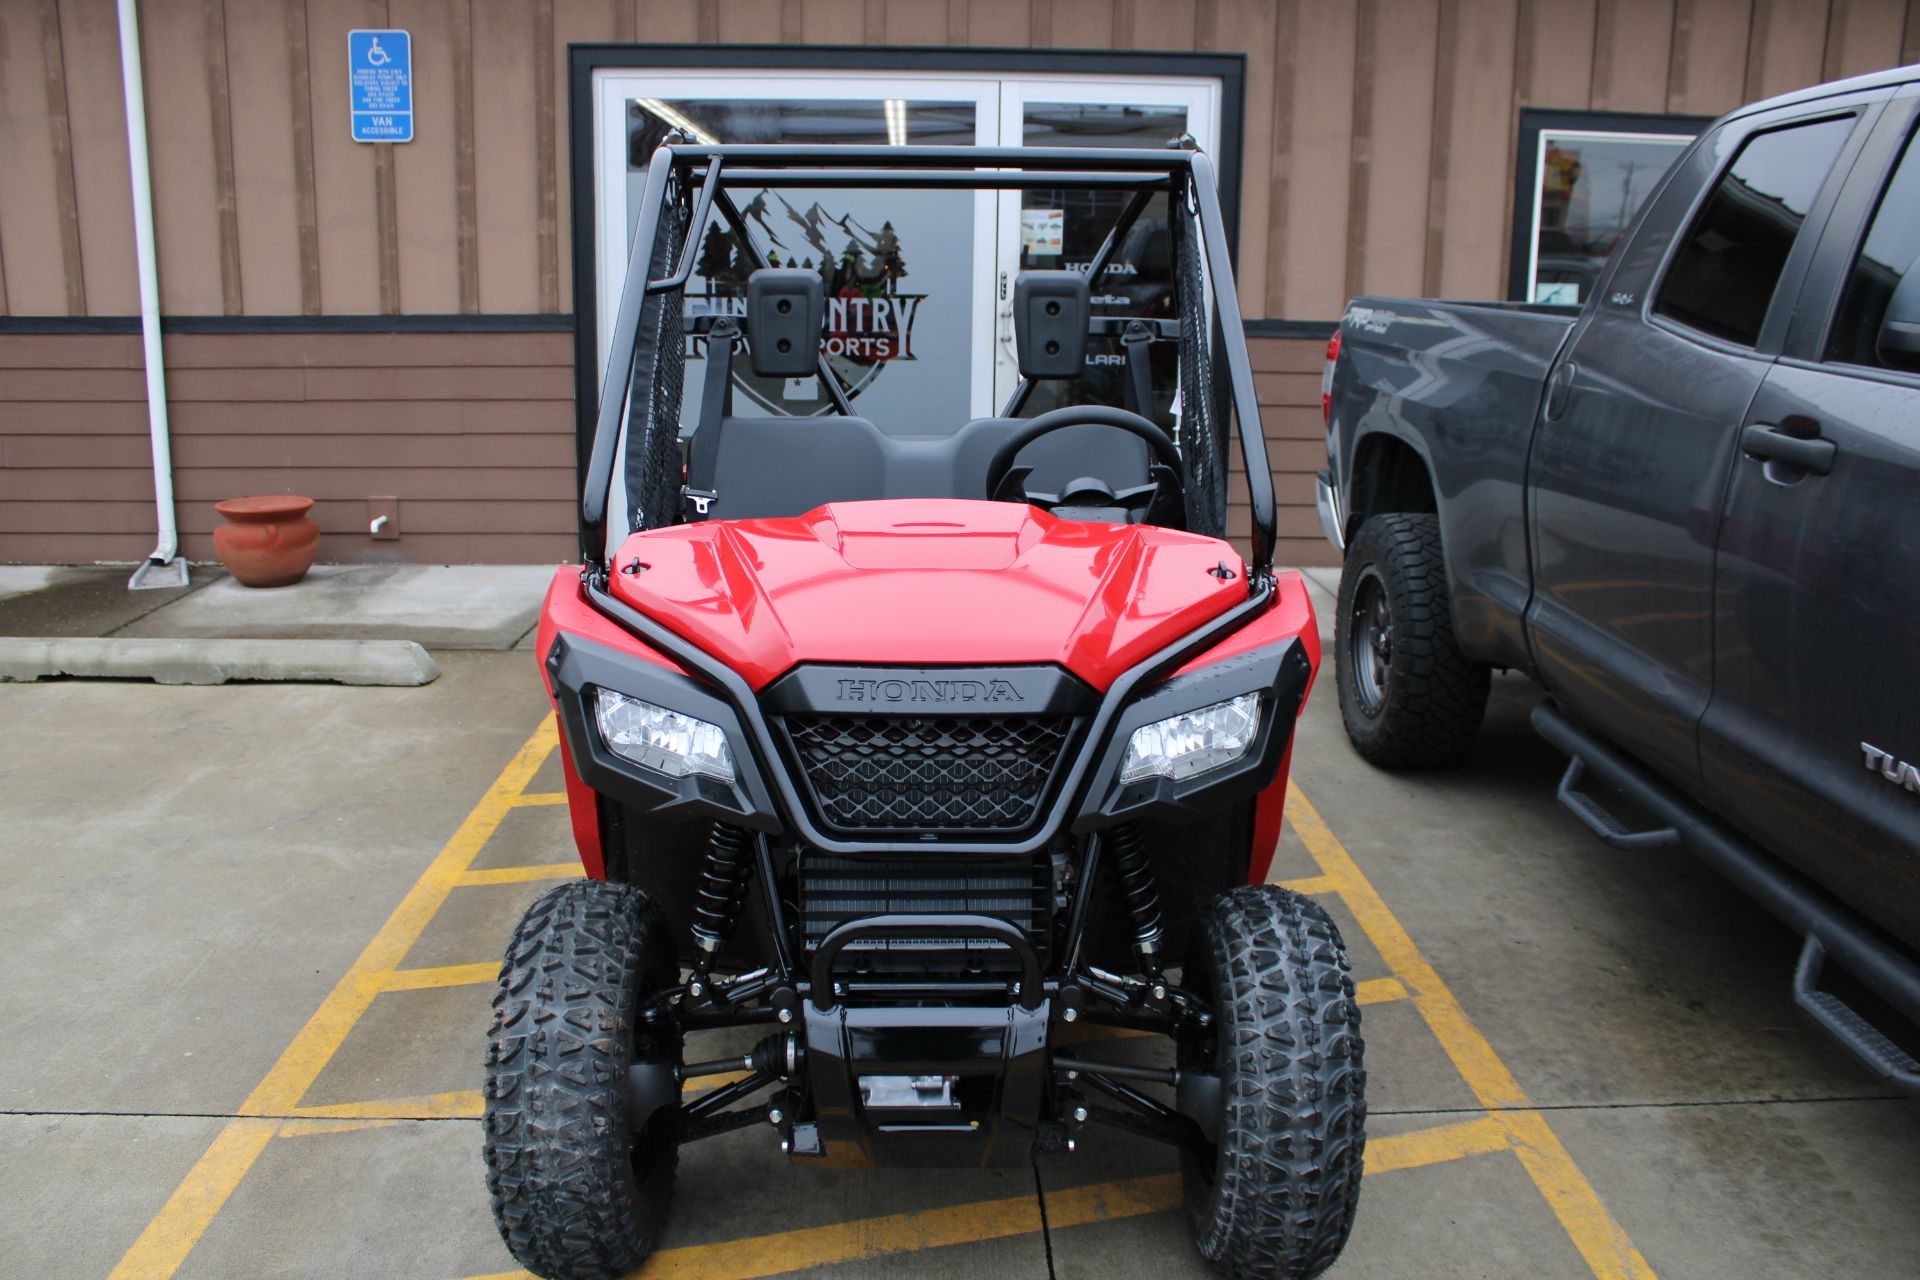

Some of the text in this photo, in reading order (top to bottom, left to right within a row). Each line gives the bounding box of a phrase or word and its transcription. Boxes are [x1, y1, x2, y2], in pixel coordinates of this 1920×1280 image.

[372, 116, 393, 126] VAN
[361, 126, 404, 135] ACCESSIBLE
[1065, 262, 1138, 275] HODA
[822, 297, 920, 357] NTRY
[1085, 354, 1126, 366] LARI
[837, 679, 1025, 702] HONDA
